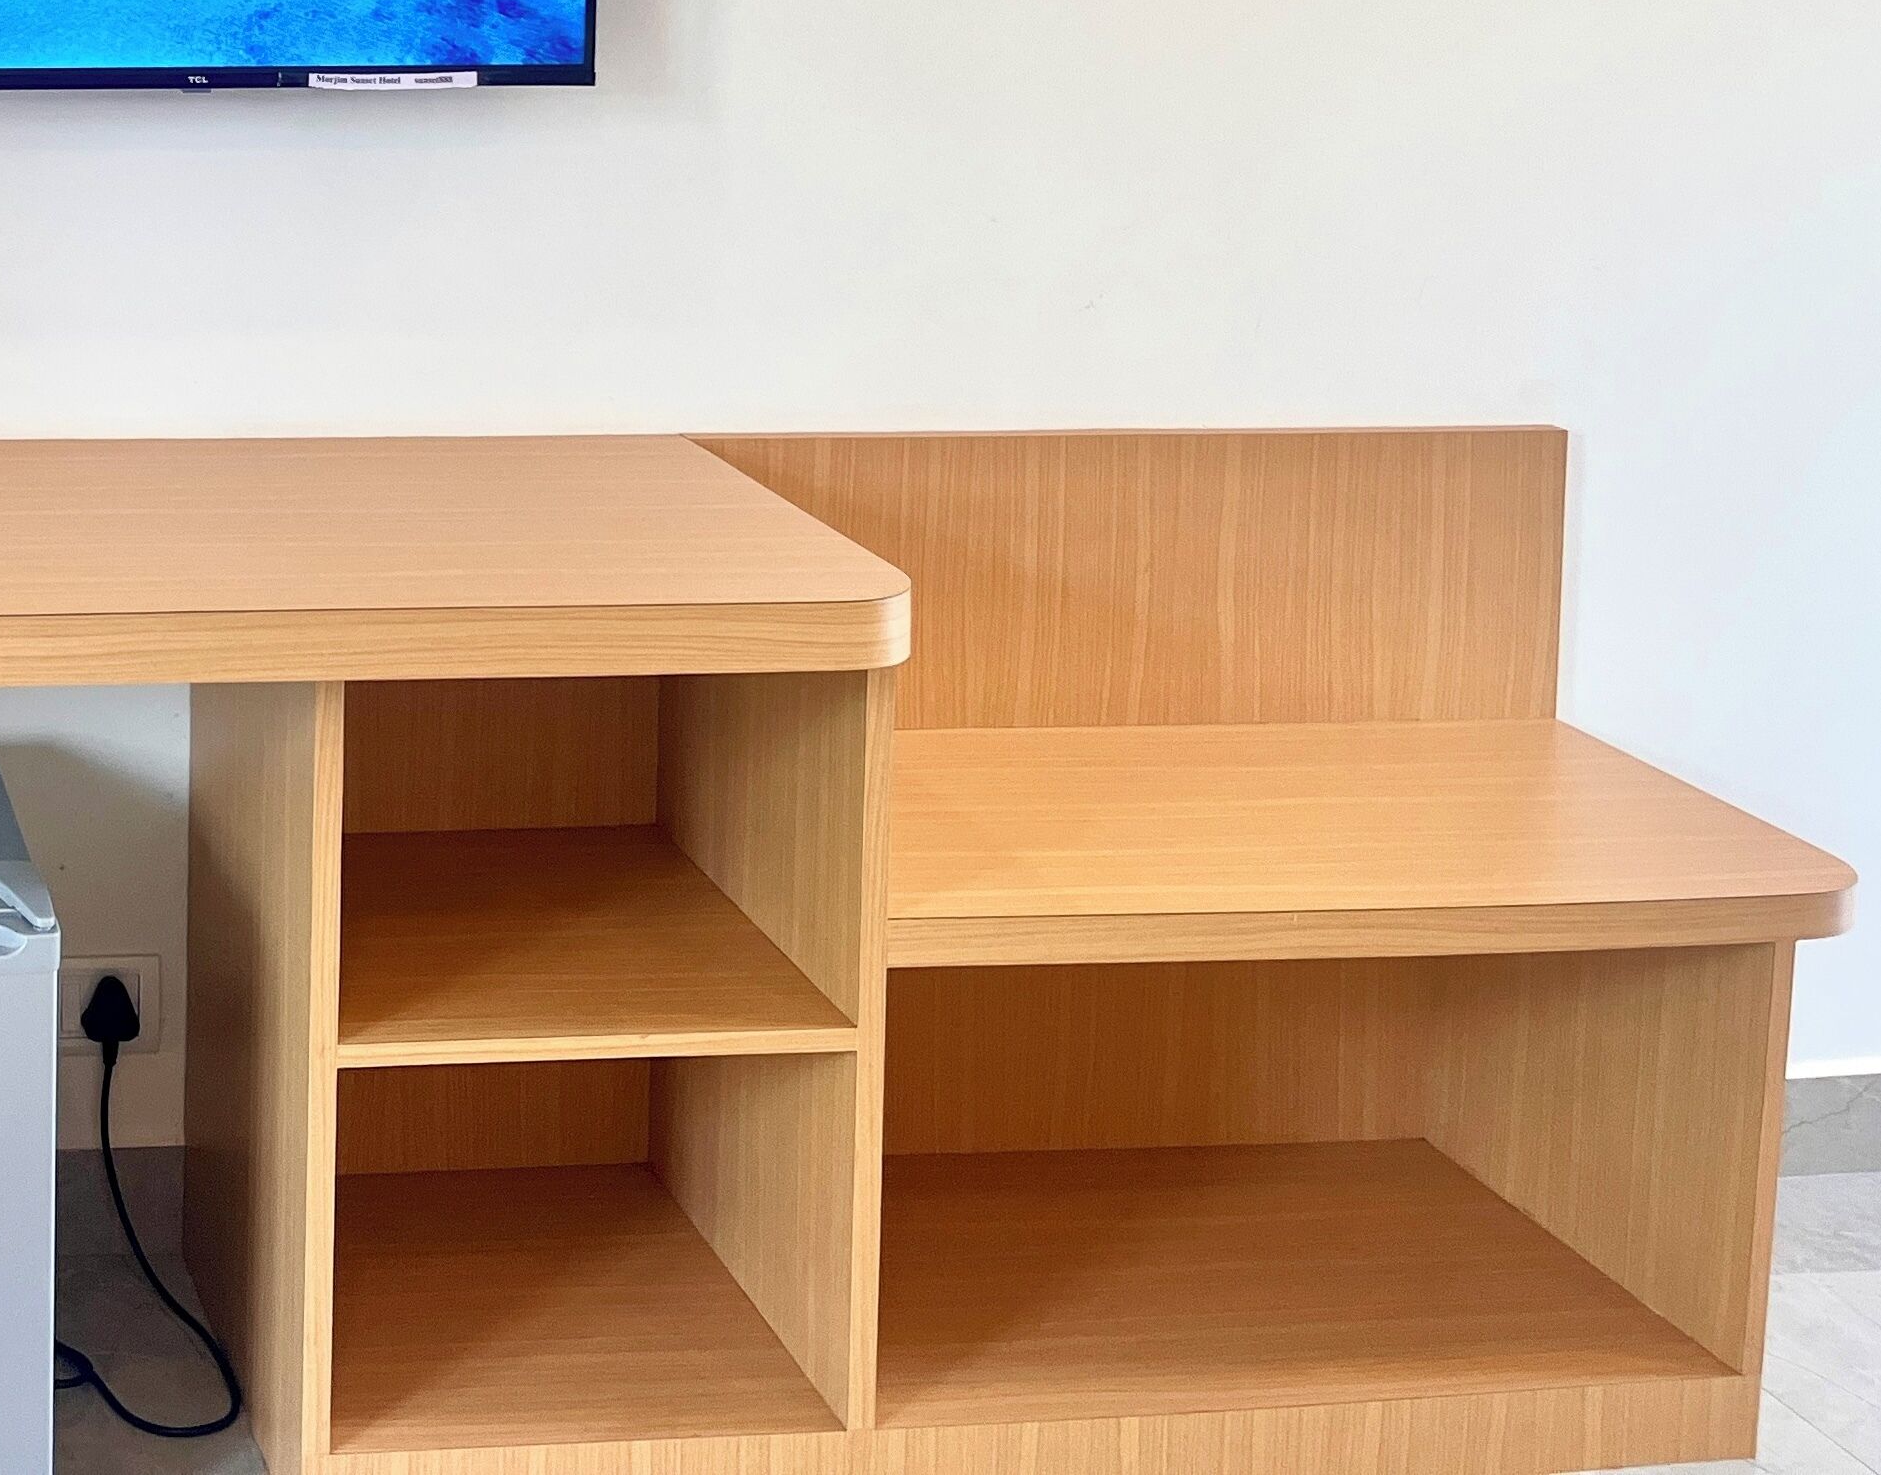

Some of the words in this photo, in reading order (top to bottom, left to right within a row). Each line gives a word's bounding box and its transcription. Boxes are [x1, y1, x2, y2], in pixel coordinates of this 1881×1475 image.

[187, 75, 209, 84] TCL
[350, 76, 377, 84] Sunset
[378, 76, 401, 84] Hotel
